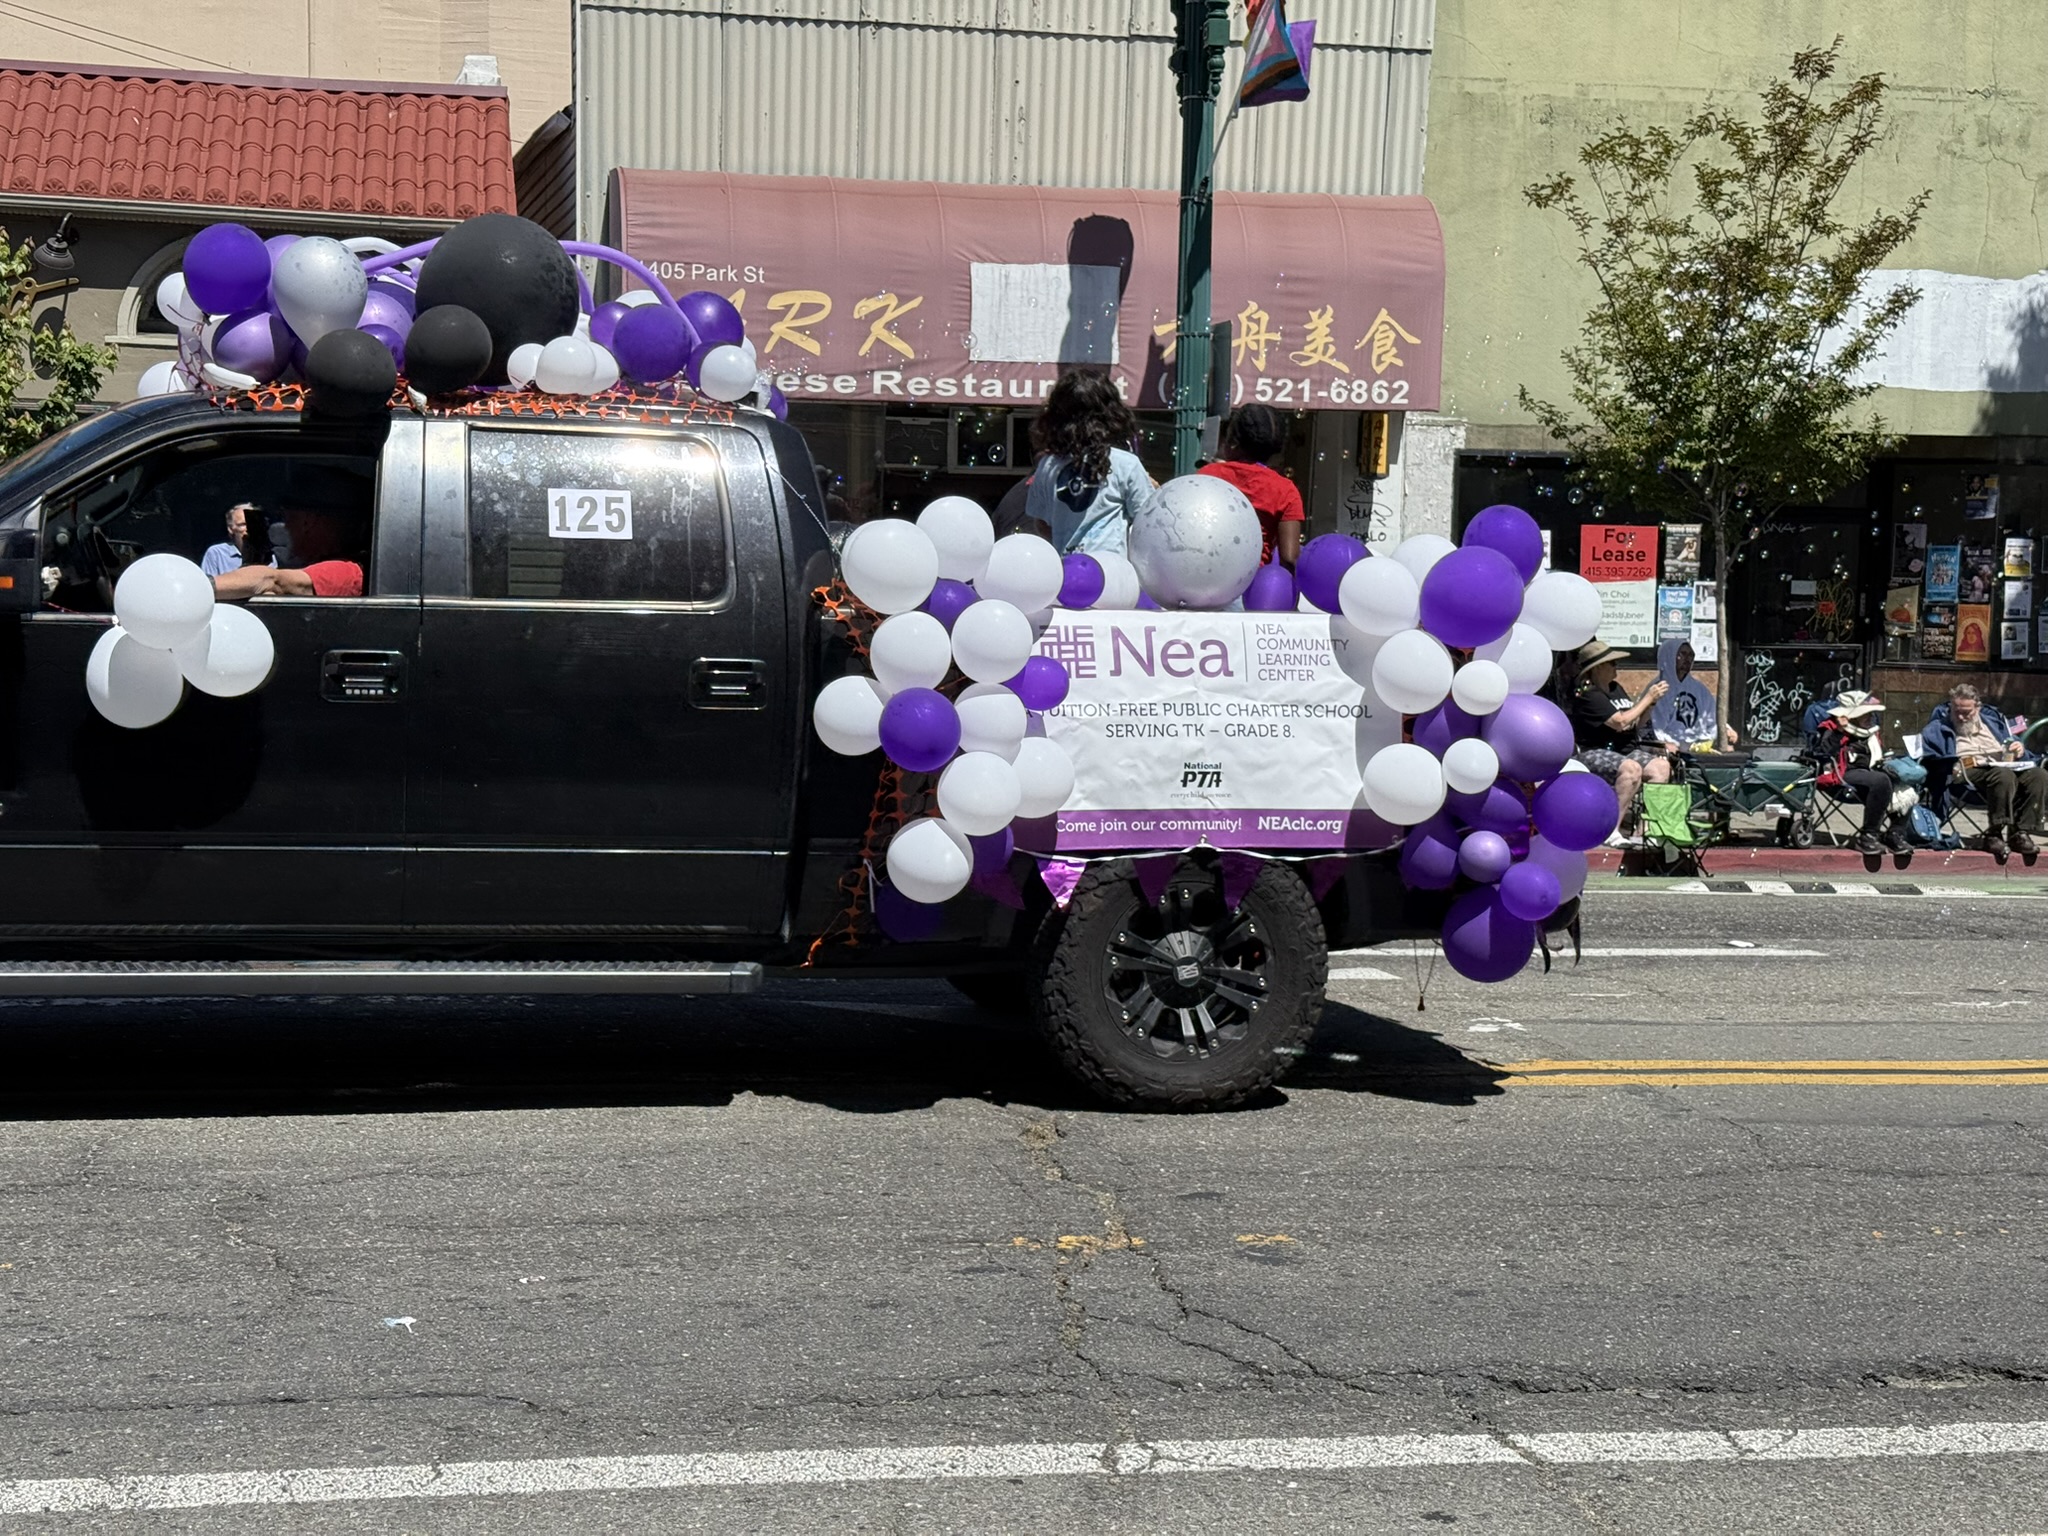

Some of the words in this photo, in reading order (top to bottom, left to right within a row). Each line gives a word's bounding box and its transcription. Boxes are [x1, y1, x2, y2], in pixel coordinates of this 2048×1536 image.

[639, 260, 686, 280] 405
[691, 263, 738, 283] Park
[743, 265, 765, 284] St
[873, 370, 1129, 400] Restaurt
[1255, 377, 1410, 405] 521-6862
[554, 495, 626, 533] 125
[1603, 528, 1636, 544] For
[1591, 546, 1646, 562] Lease
[1610, 590, 1630, 598] Choi
[1255, 624, 1285, 635] NEA
[1256, 638, 1350, 651] COMMUNITY
[1640, 636, 1651, 644] JLL
[1109, 625, 1234, 679] Nea
[1257, 653, 1331, 667] LEARNING
[1258, 668, 1316, 682] CENTER
[1162, 702, 1222, 718] PUBLIC
[1225, 703, 1301, 719] CHARTER
[1304, 704, 1373, 720] SCHOOL
[1105, 723, 1180, 739] SERVING
[1182, 723, 1205, 739] TK
[1224, 723, 1279, 739] GRADE
[1282, 724, 1296, 739] 8.
[1183, 761, 1222, 770] National
[1180, 770, 1223, 788] PTA
[1056, 819, 1097, 833] Come
[1100, 818, 1127, 834] join
[1131, 820, 1156, 832] our
[1159, 817, 1242, 834] community!
[1257, 816, 1343, 834] NEAclc.org
